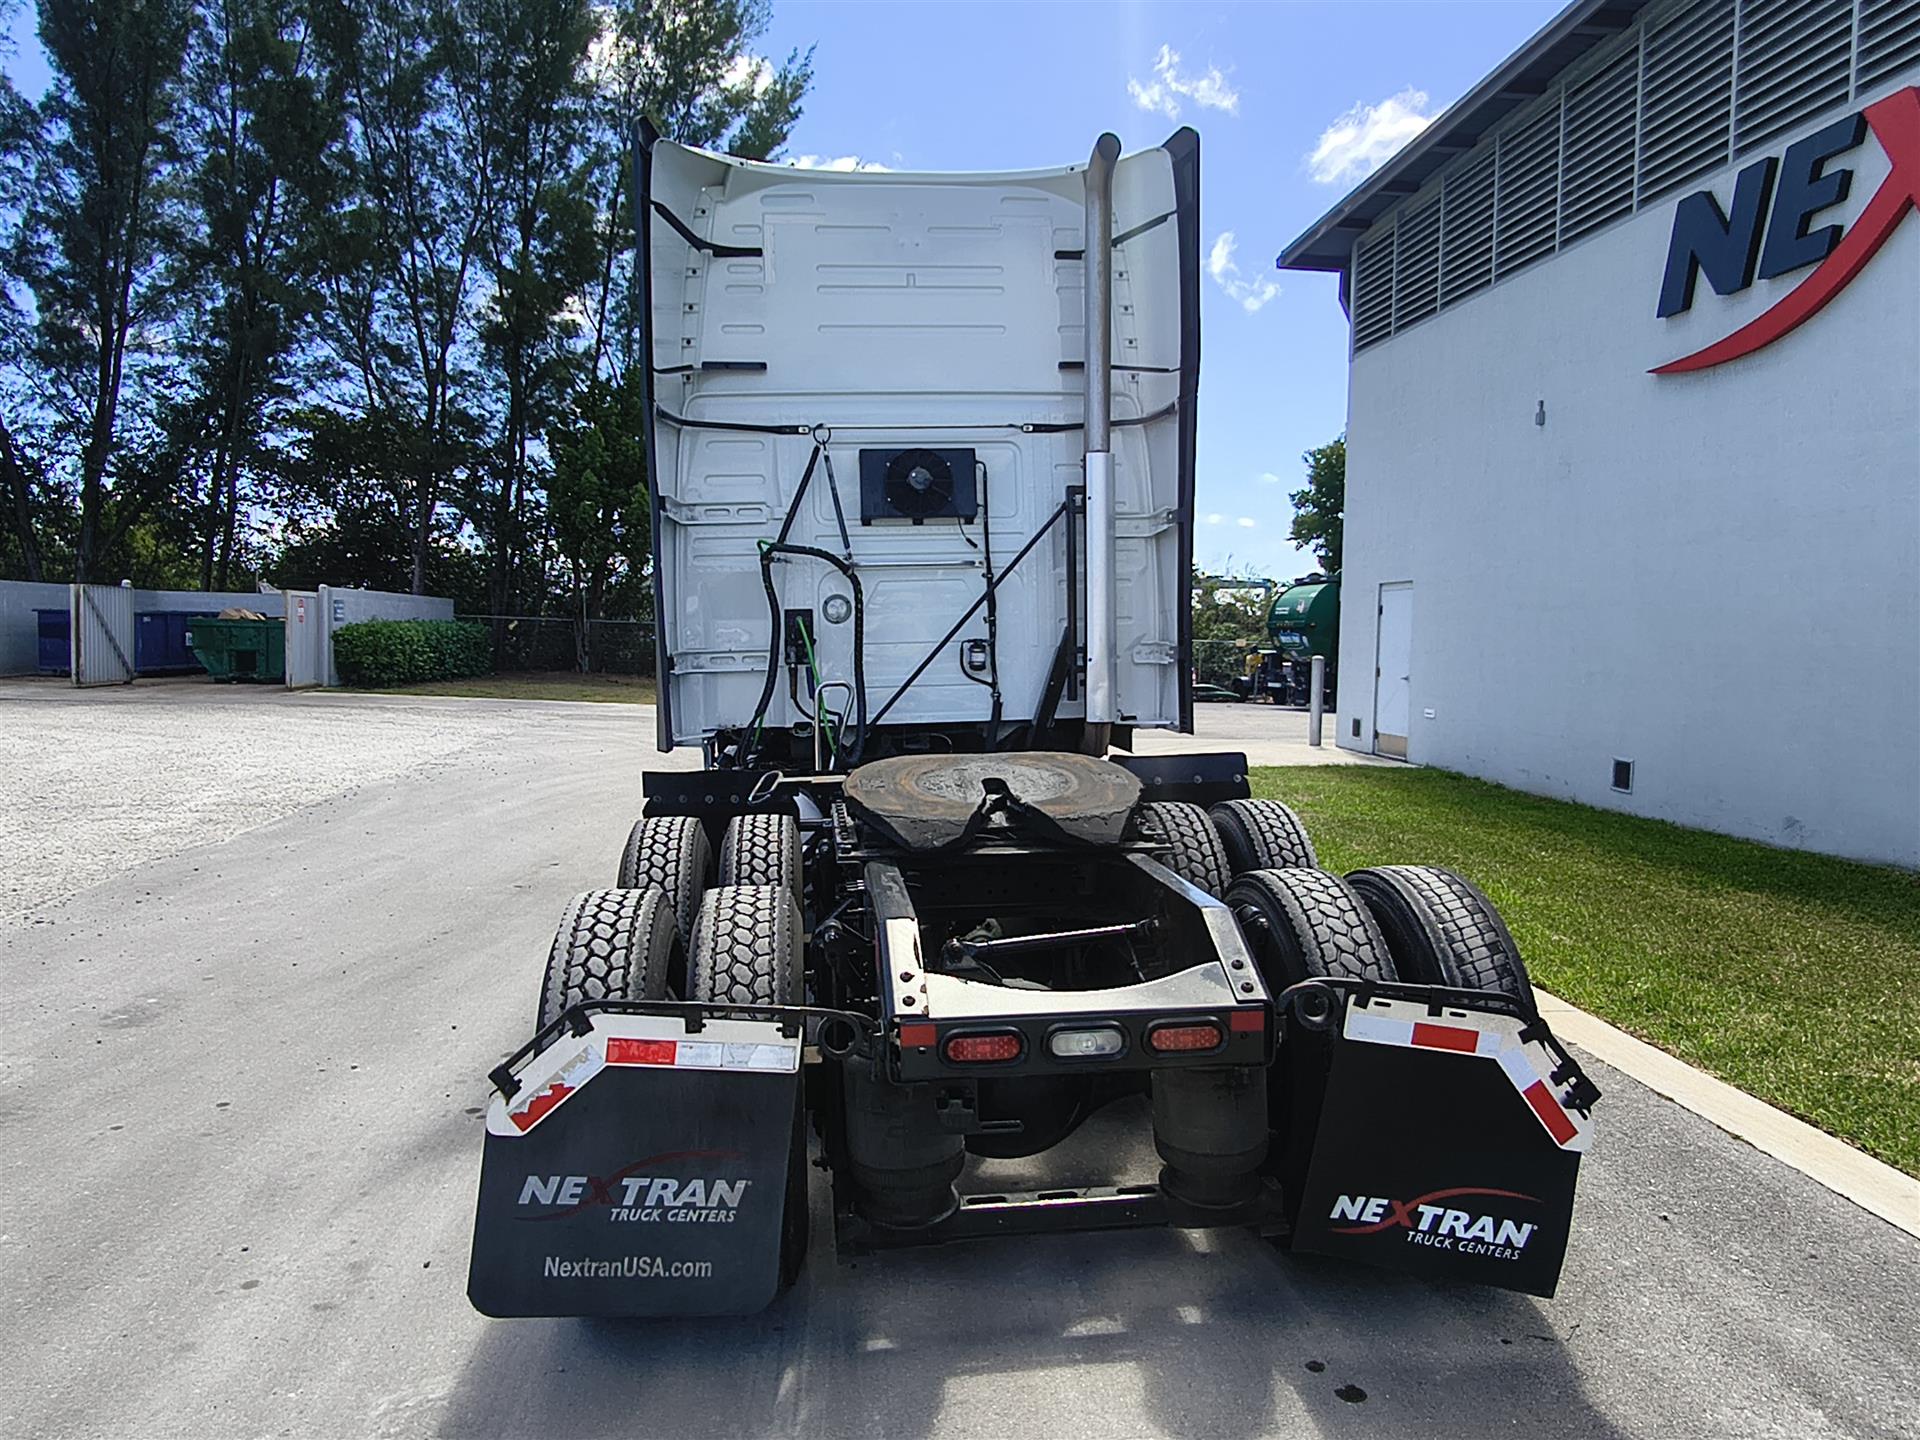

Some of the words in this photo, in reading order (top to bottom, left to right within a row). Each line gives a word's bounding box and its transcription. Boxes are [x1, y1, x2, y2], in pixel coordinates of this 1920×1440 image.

[518, 1175, 746, 1208] NEXTRAN
[610, 1208, 661, 1222] TRUCK
[667, 1208, 736, 1223] CENTERS
[1329, 1194, 1534, 1248] NEXTRAN
[1407, 1231, 1453, 1249] TRUCK
[1458, 1241, 1521, 1261] CENTERS
[544, 1256, 713, 1278] NextranUSA.com
